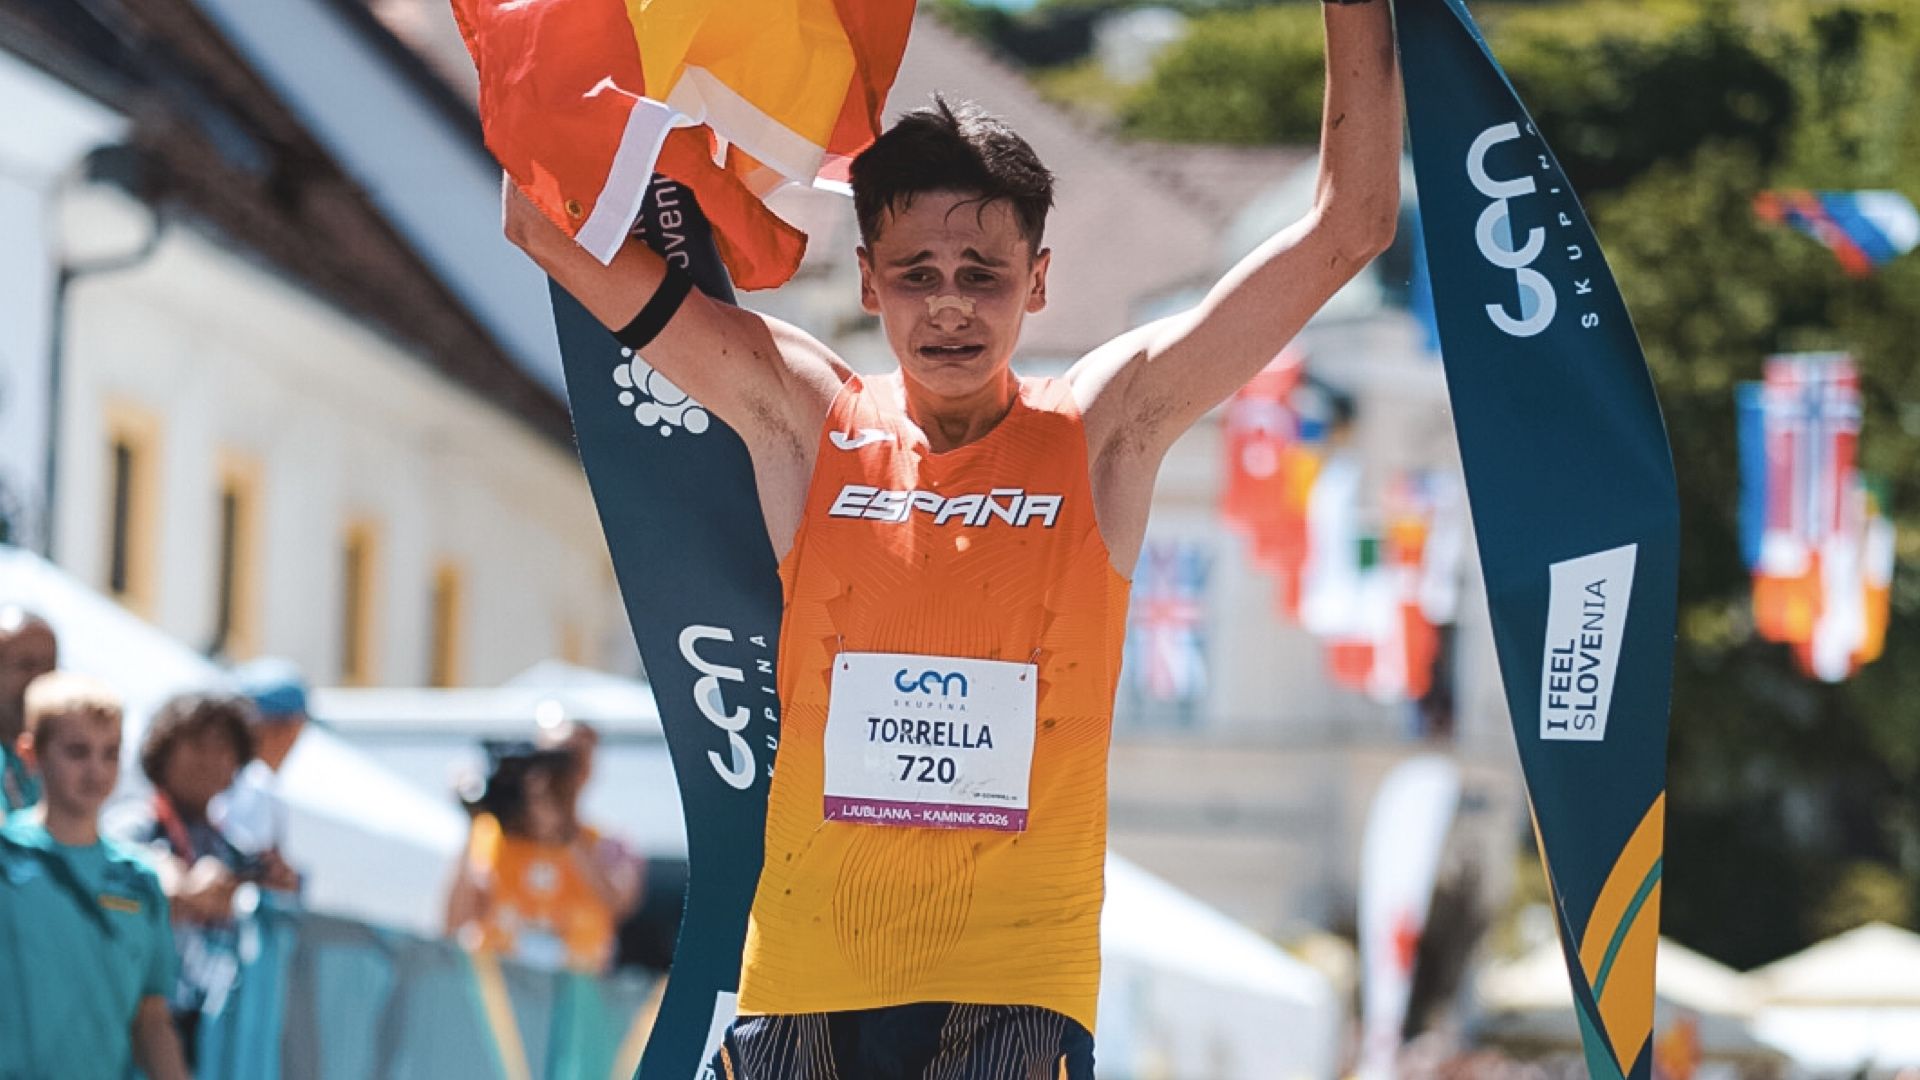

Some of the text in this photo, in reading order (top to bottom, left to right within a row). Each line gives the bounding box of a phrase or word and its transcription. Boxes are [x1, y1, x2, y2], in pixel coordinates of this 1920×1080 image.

[654, 178, 690, 269] oveni
[828, 484, 1064, 527] ESPAÑA
[1573, 578, 1608, 731] SLOVENIA
[893, 699, 967, 712] SKUPINA
[1547, 638, 1575, 731] I FEEL
[750, 635, 778, 778] KUPINA
[867, 717, 994, 749] TORRELLA
[897, 754, 956, 784] 720
[841, 804, 912, 821] LJUBLJANA
[922, 809, 976, 824] KAMNIK
[978, 812, 1009, 826] 2026
